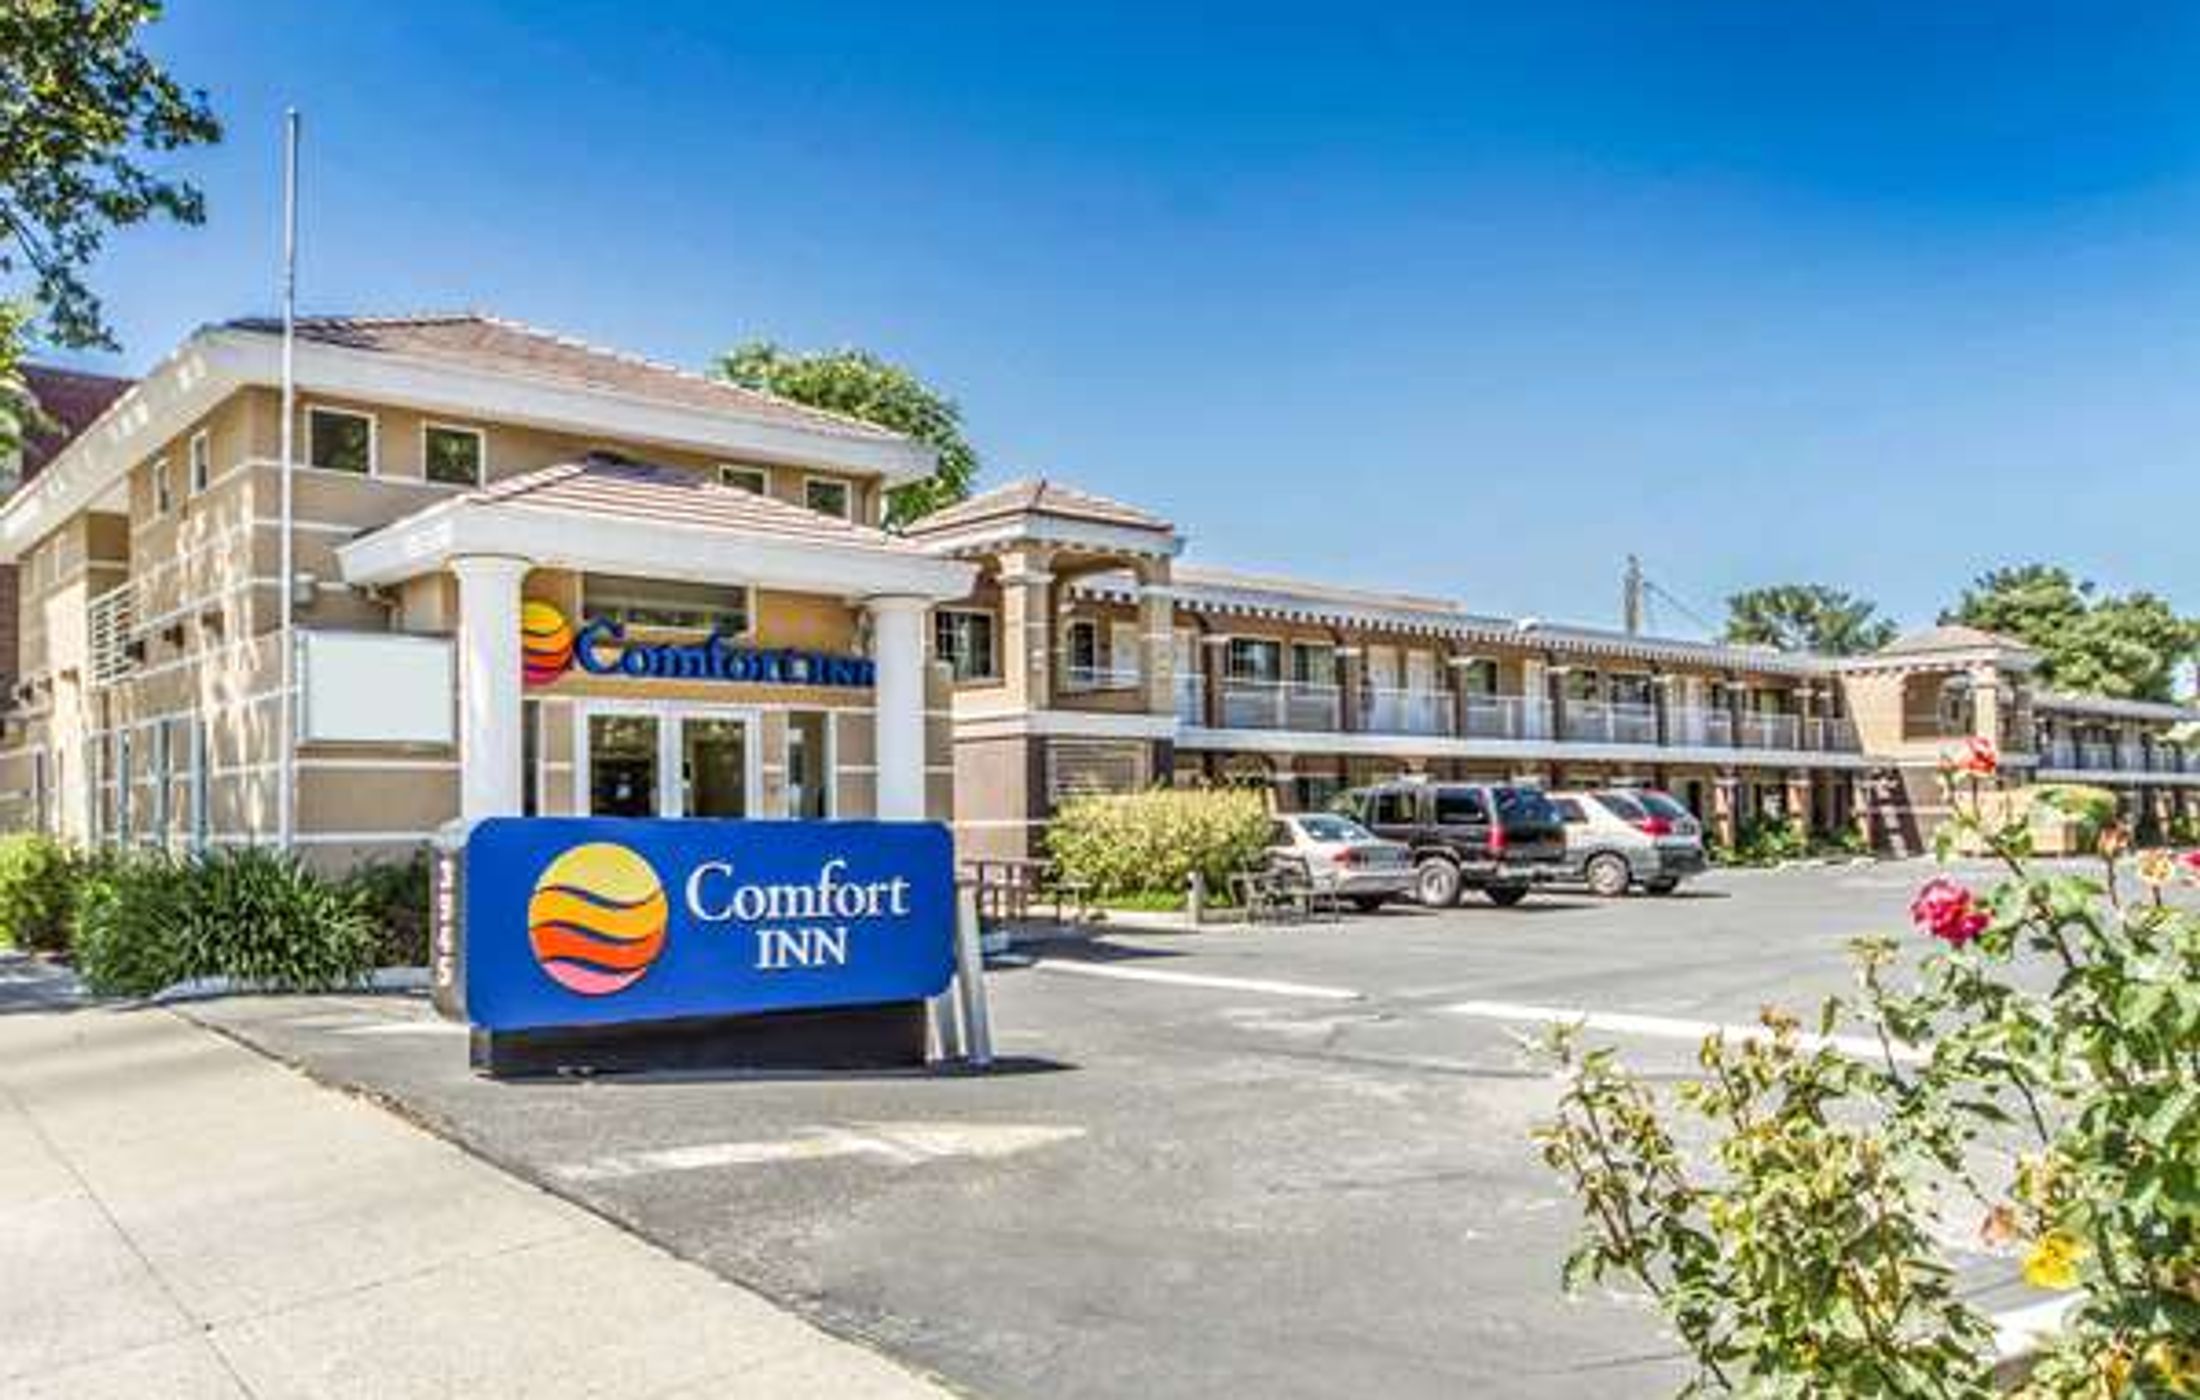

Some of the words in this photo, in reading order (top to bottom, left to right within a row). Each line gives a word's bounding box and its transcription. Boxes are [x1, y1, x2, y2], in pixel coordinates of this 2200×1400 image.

[575, 617, 808, 684] Comfort
[685, 859, 911, 921] Comfort
[754, 926, 849, 969] INN
